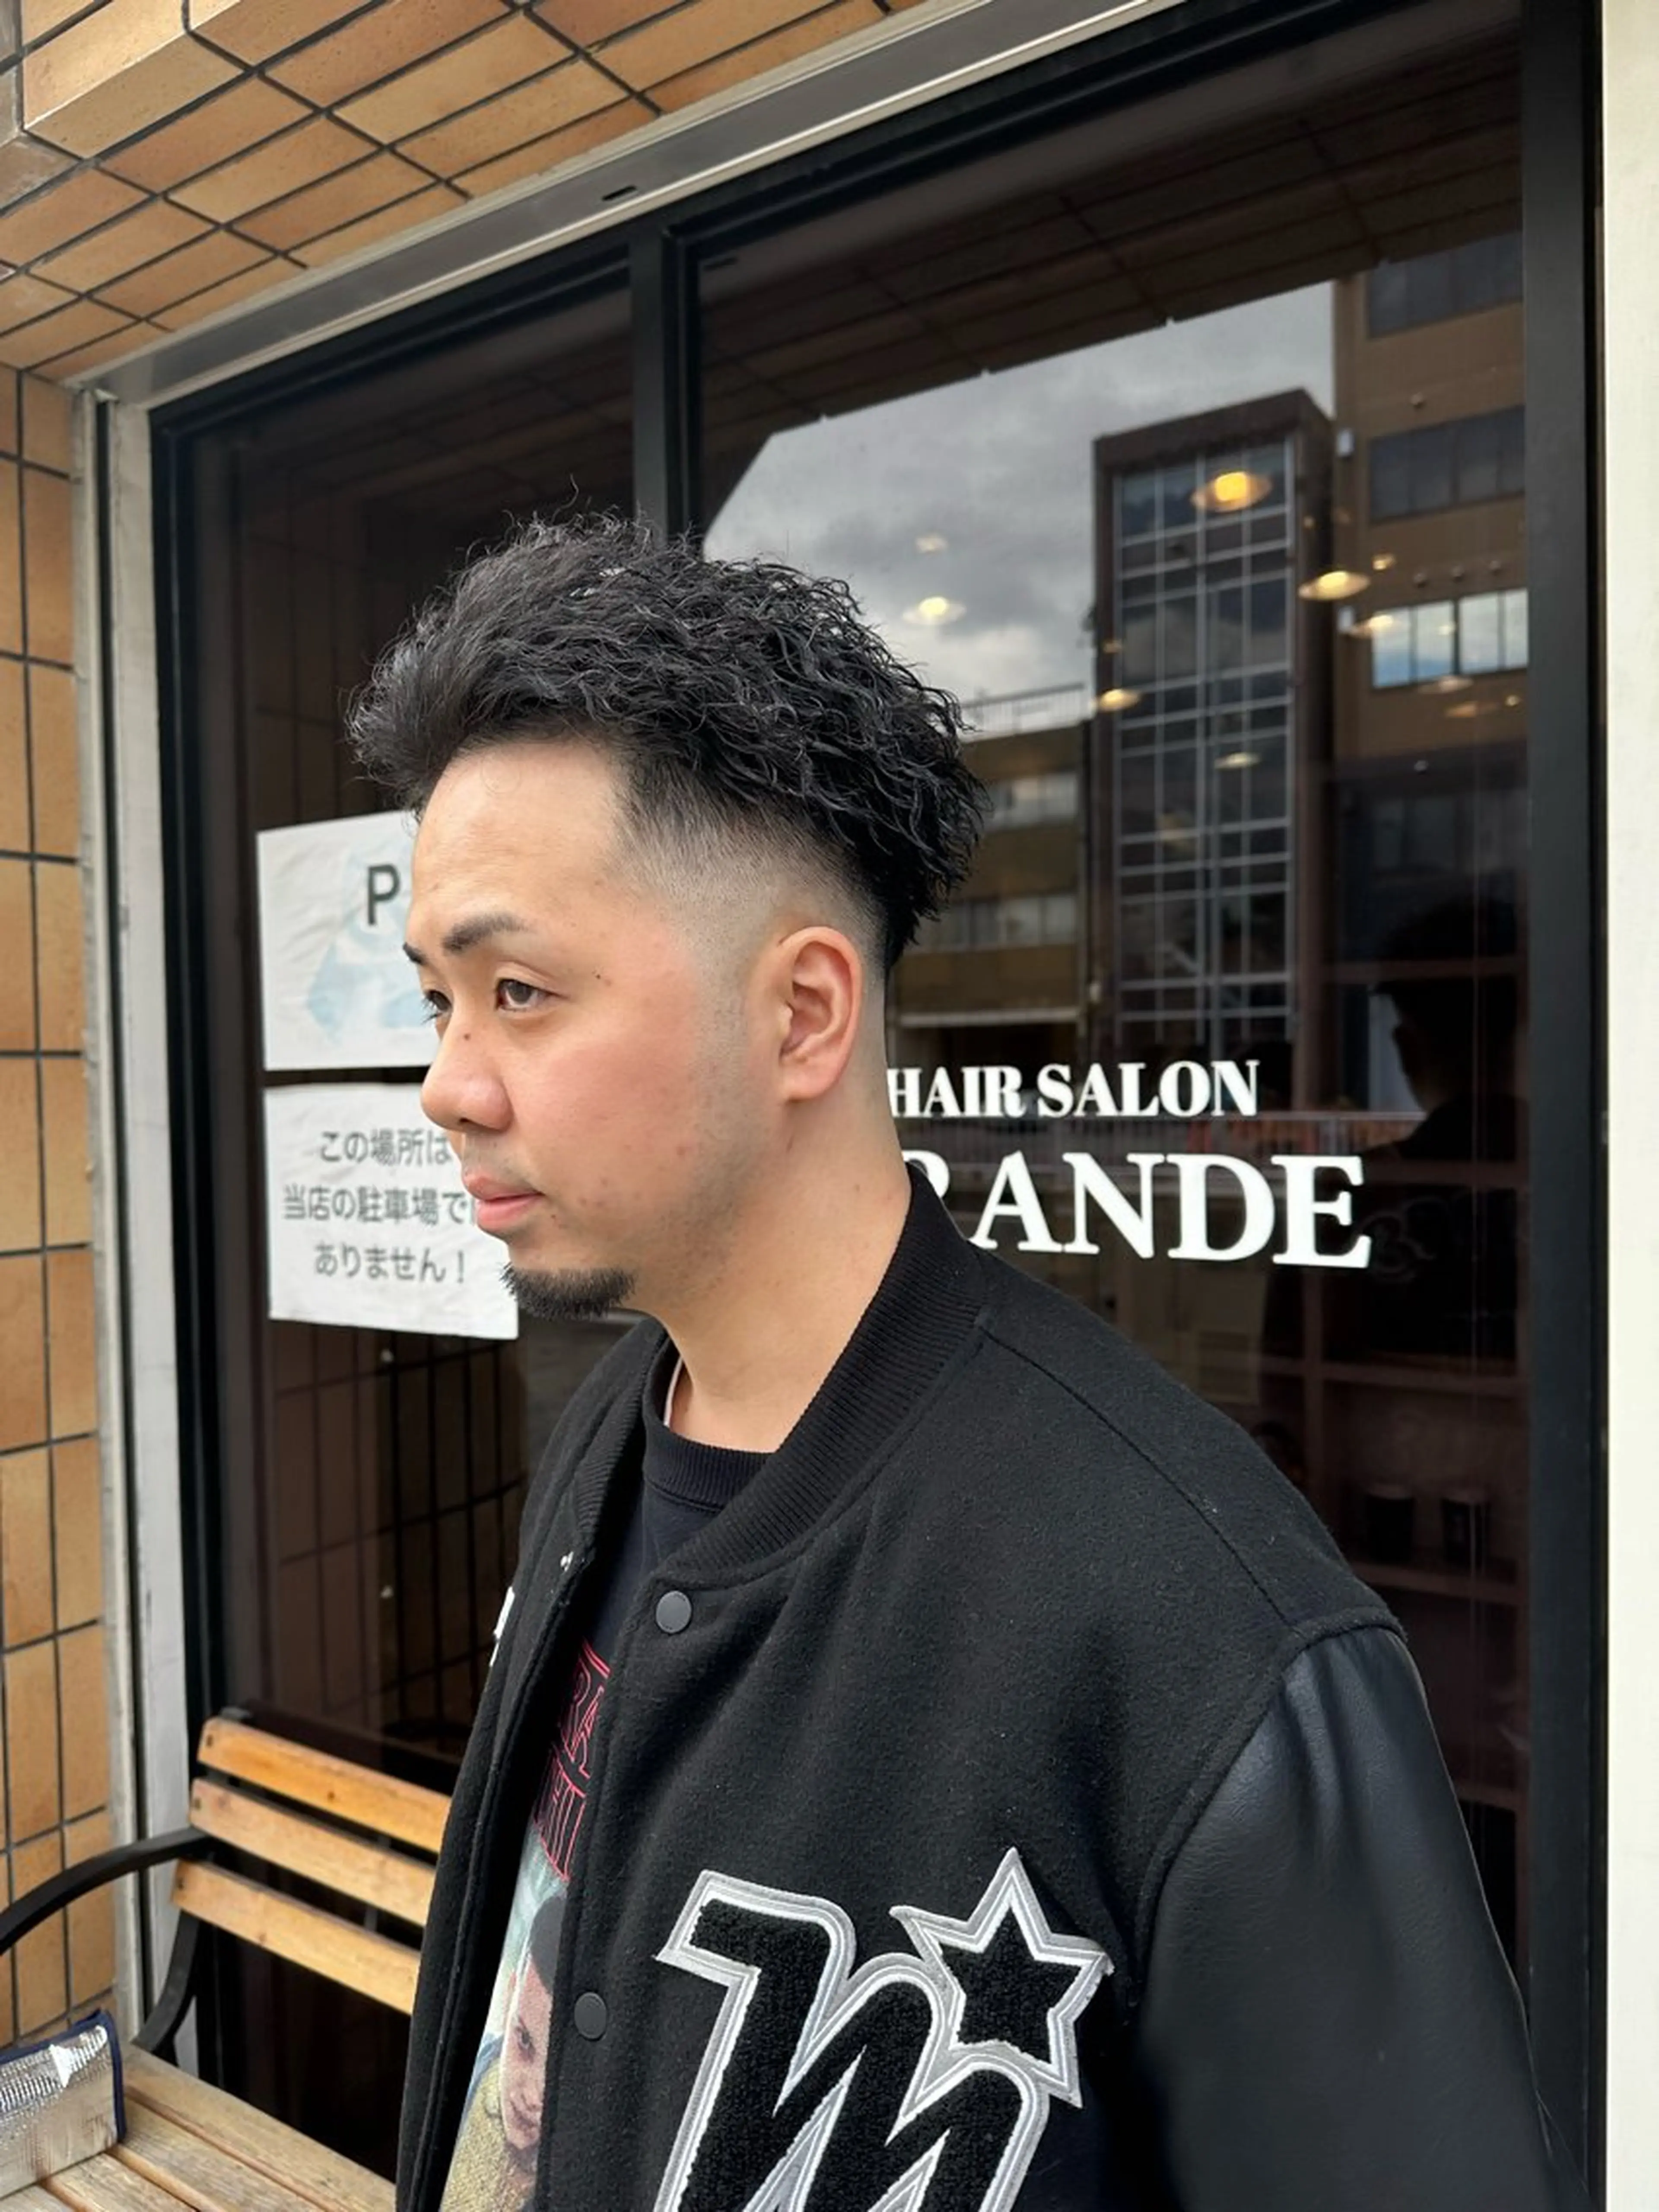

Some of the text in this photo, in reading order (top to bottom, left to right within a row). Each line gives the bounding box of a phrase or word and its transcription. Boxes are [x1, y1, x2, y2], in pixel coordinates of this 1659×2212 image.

[887, 1059, 1260, 1118] HAIR SALON
[320, 1128, 452, 1166] この場所は
[283, 1183, 476, 1226] 当店の駐車場で
